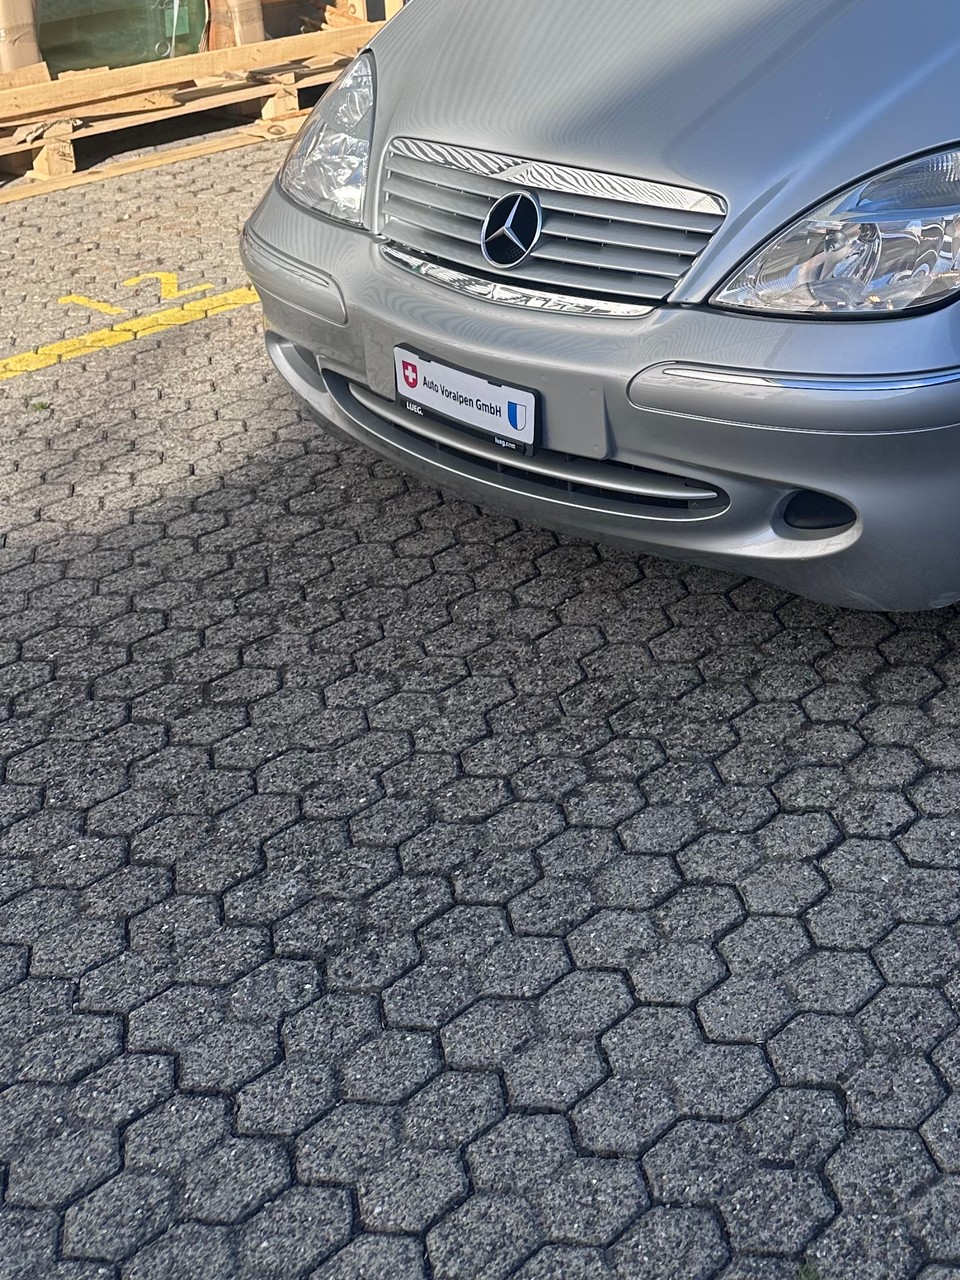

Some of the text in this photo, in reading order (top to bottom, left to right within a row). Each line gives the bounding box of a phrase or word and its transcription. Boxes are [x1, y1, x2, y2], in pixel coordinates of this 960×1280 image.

[423, 376, 502, 417] Auto Voralpen GmbH
[494, 436, 516, 449] lueg.com
